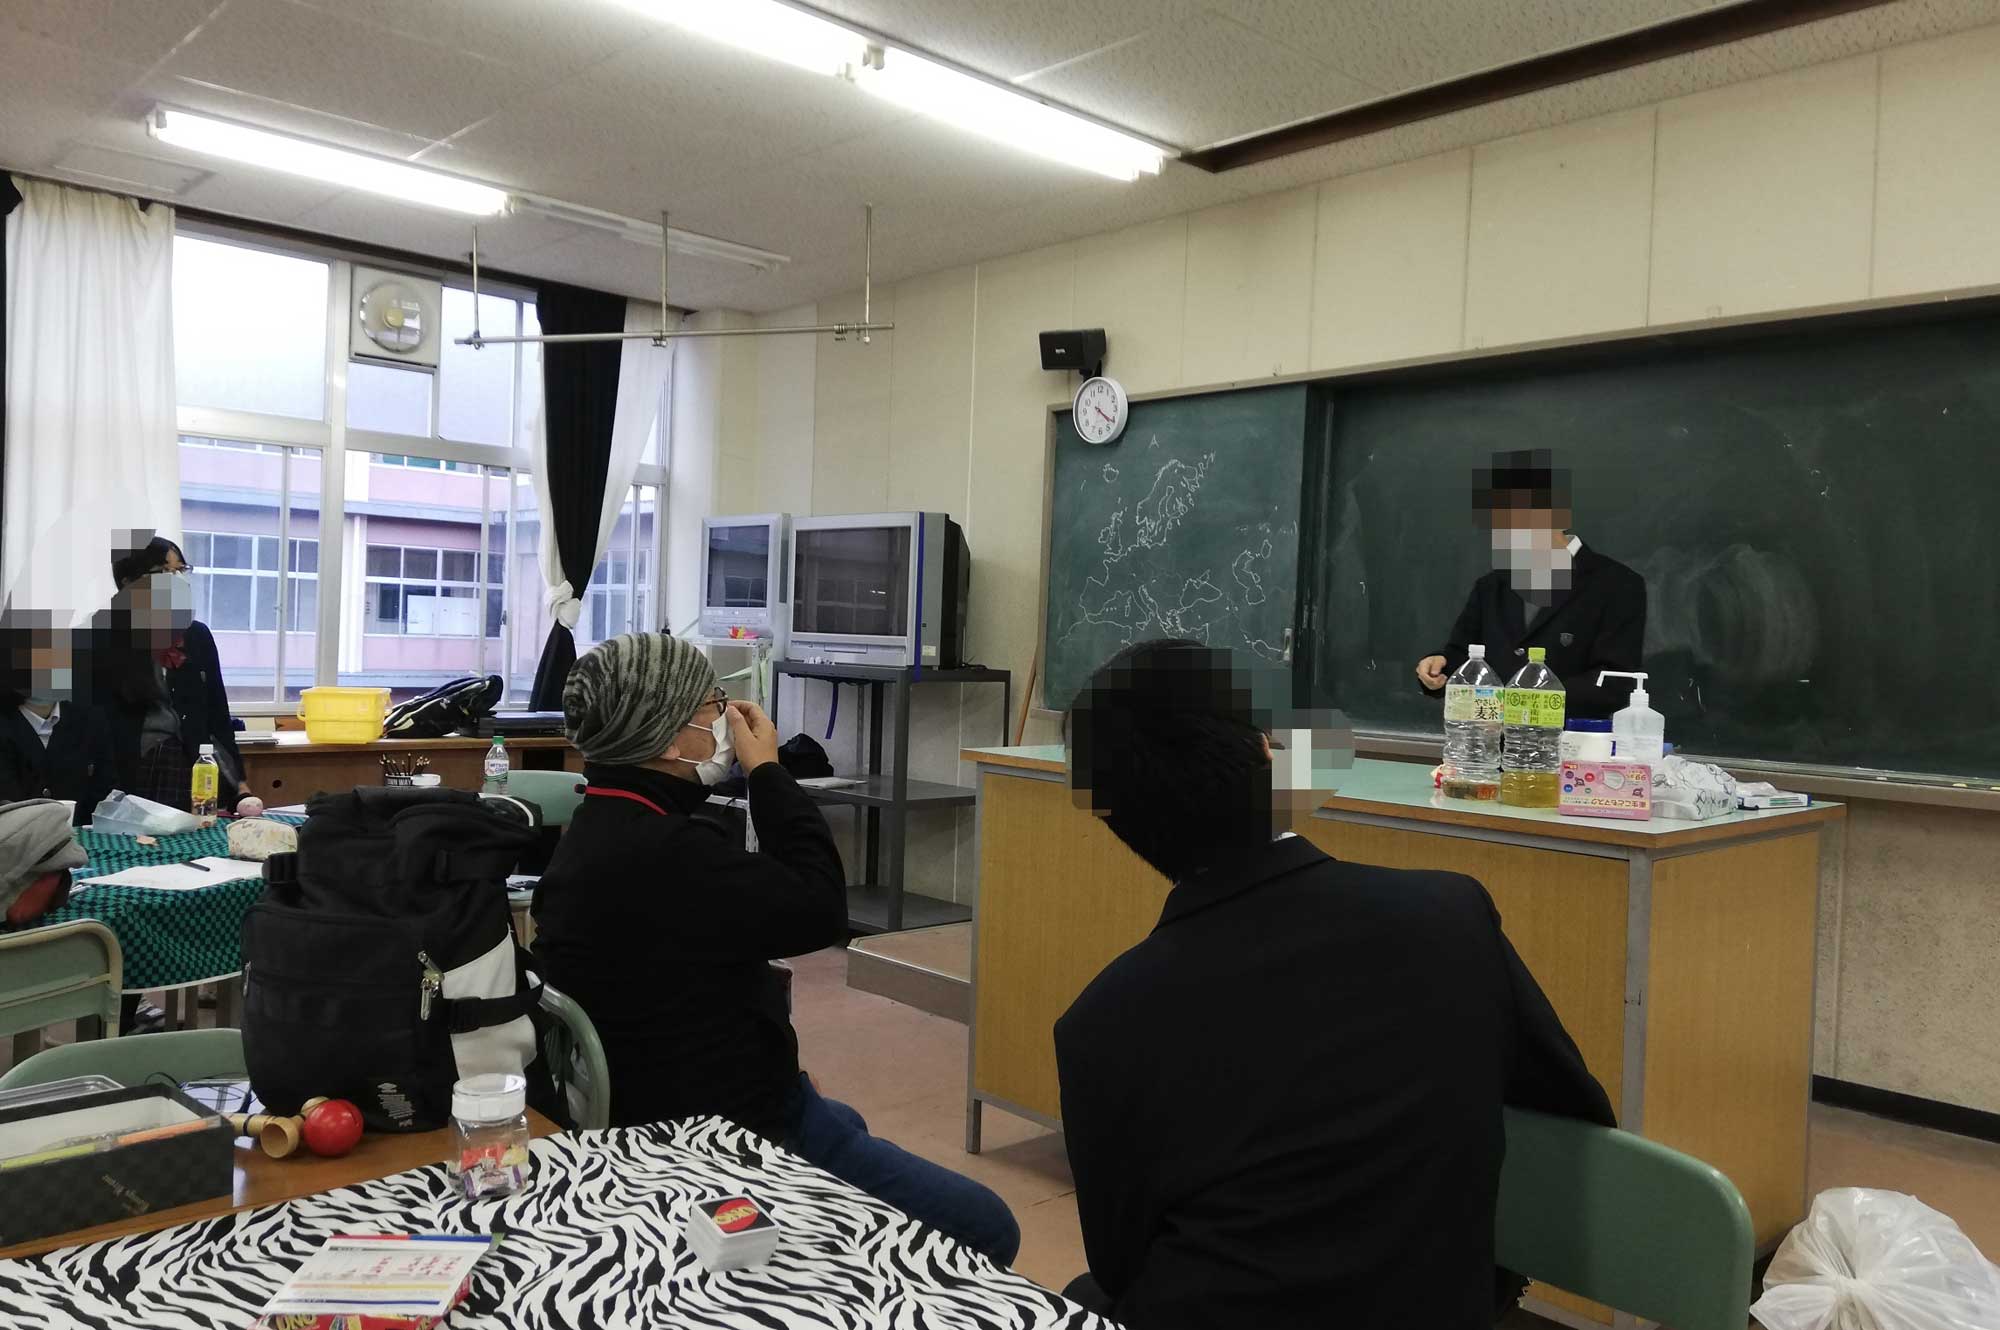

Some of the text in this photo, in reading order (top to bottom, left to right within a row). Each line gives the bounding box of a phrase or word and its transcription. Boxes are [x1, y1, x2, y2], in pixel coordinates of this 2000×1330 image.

[1097, 385, 1103, 393] 12
[1085, 399, 1091, 407] 10
[1082, 408, 1087, 416] 9
[1474, 698, 1498, 707] やさしい
[1474, 706, 1498, 720] 麦茶
